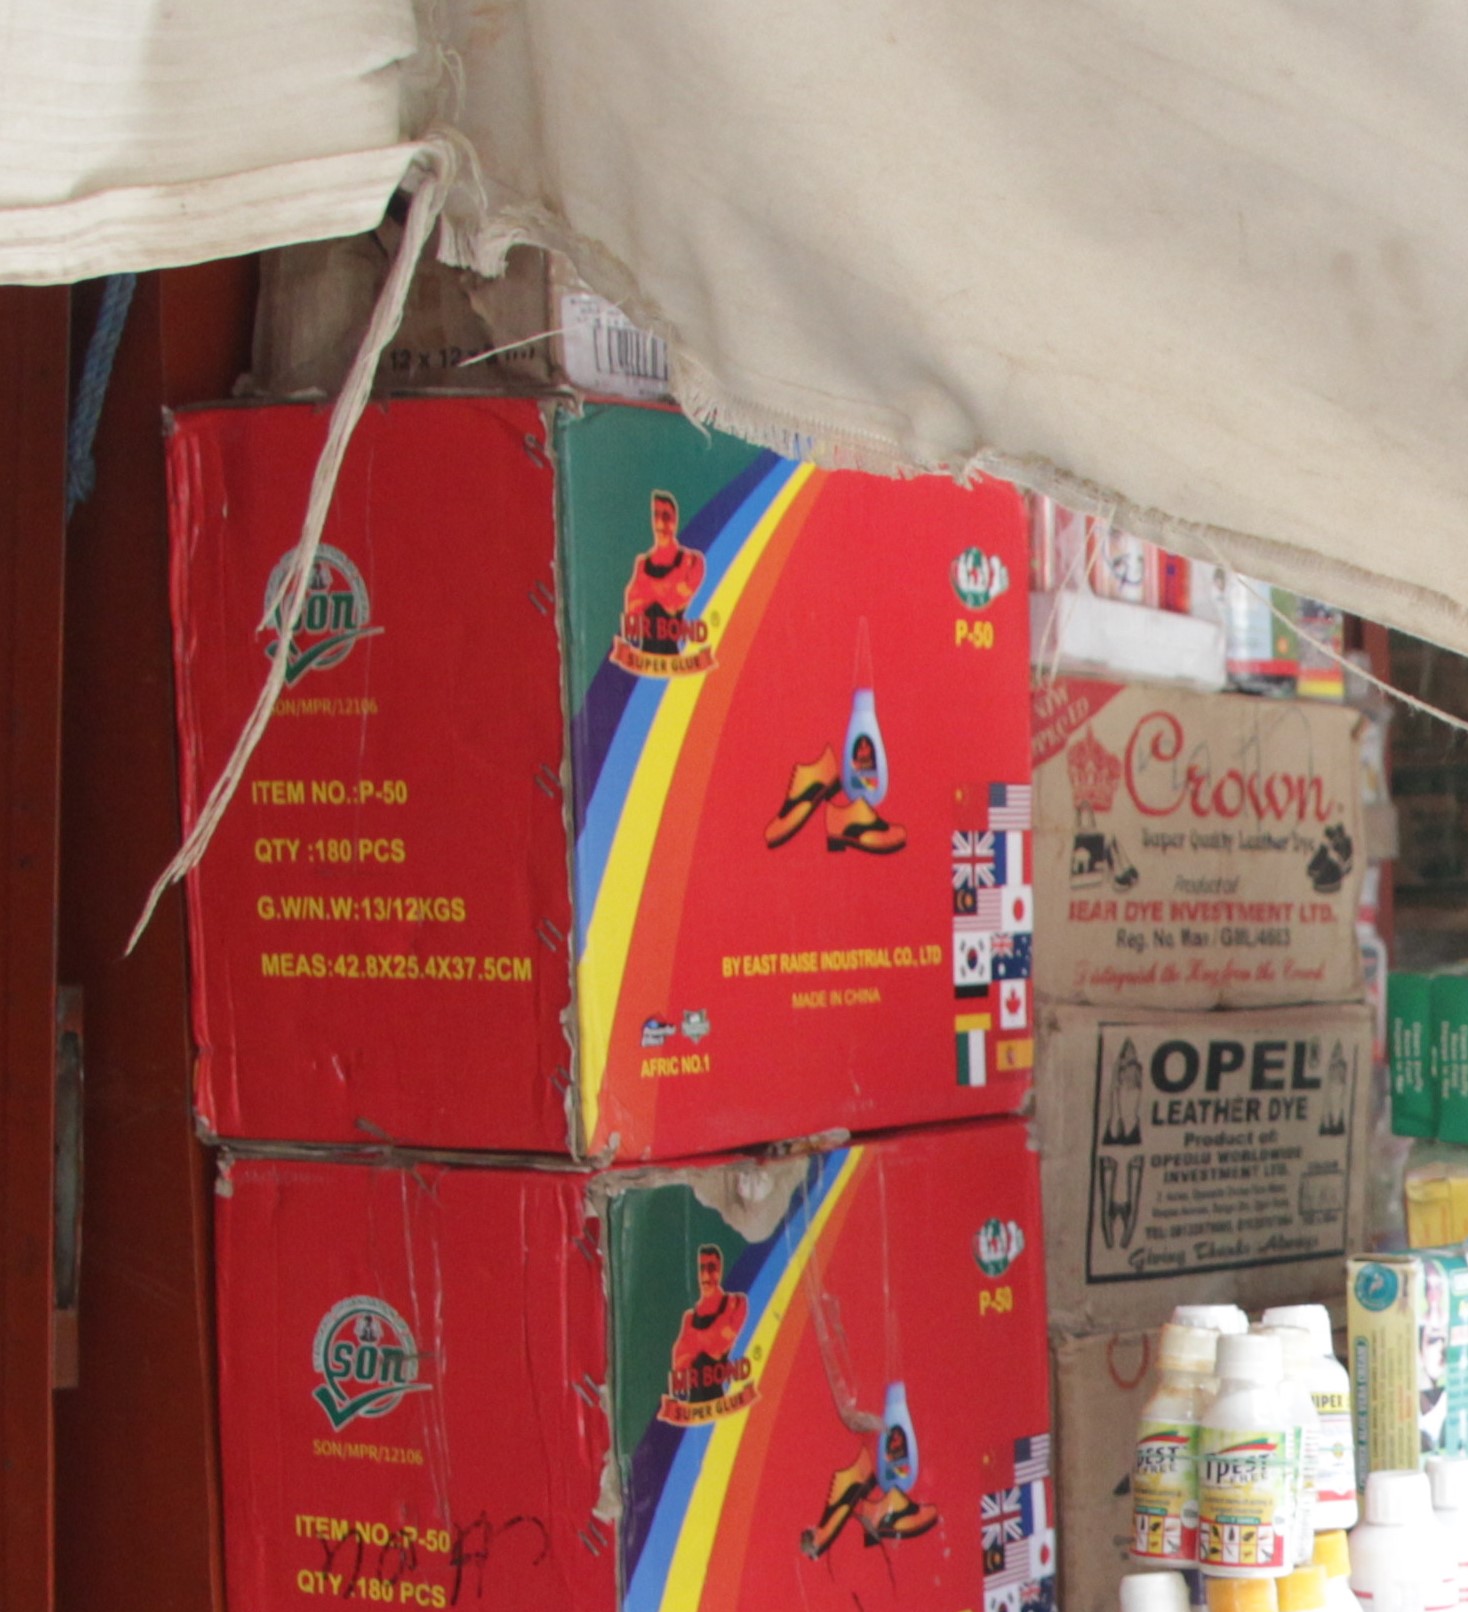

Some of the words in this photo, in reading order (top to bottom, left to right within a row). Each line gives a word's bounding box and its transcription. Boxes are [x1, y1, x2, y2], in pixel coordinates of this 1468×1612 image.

[656, 617, 708, 643] BOND
[955, 618, 994, 650] P-50
[627, 652, 668, 672] SUPER
[670, 654, 700, 672] GLUE
[1124, 710, 1335, 823] Crown
[251, 780, 305, 804] ITEM
[254, 838, 300, 864] QTY
[358, 838, 407, 863] PCS
[721, 956, 742, 978] BY
[744, 953, 778, 976] EAST
[780, 951, 818, 974] RAISE
[820, 947, 892, 972] INDUSTRIAL
[919, 944, 942, 966] LTD
[641, 1056, 678, 1078] AFRIC
[1150, 1039, 1322, 1094] OPEL
[1151, 1097, 1262, 1127] LEATHER
[1268, 1095, 1308, 1122] DYE
[979, 1286, 1013, 1316] P-50
[702, 1357, 753, 1389] BOND
[674, 1404, 712, 1422] SUPER
[313, 1438, 424, 1466] SON/MPR/12106
[295, 1513, 349, 1543] ITEM
[297, 1569, 342, 1598] QTY
[400, 1582, 447, 1609] PCS
